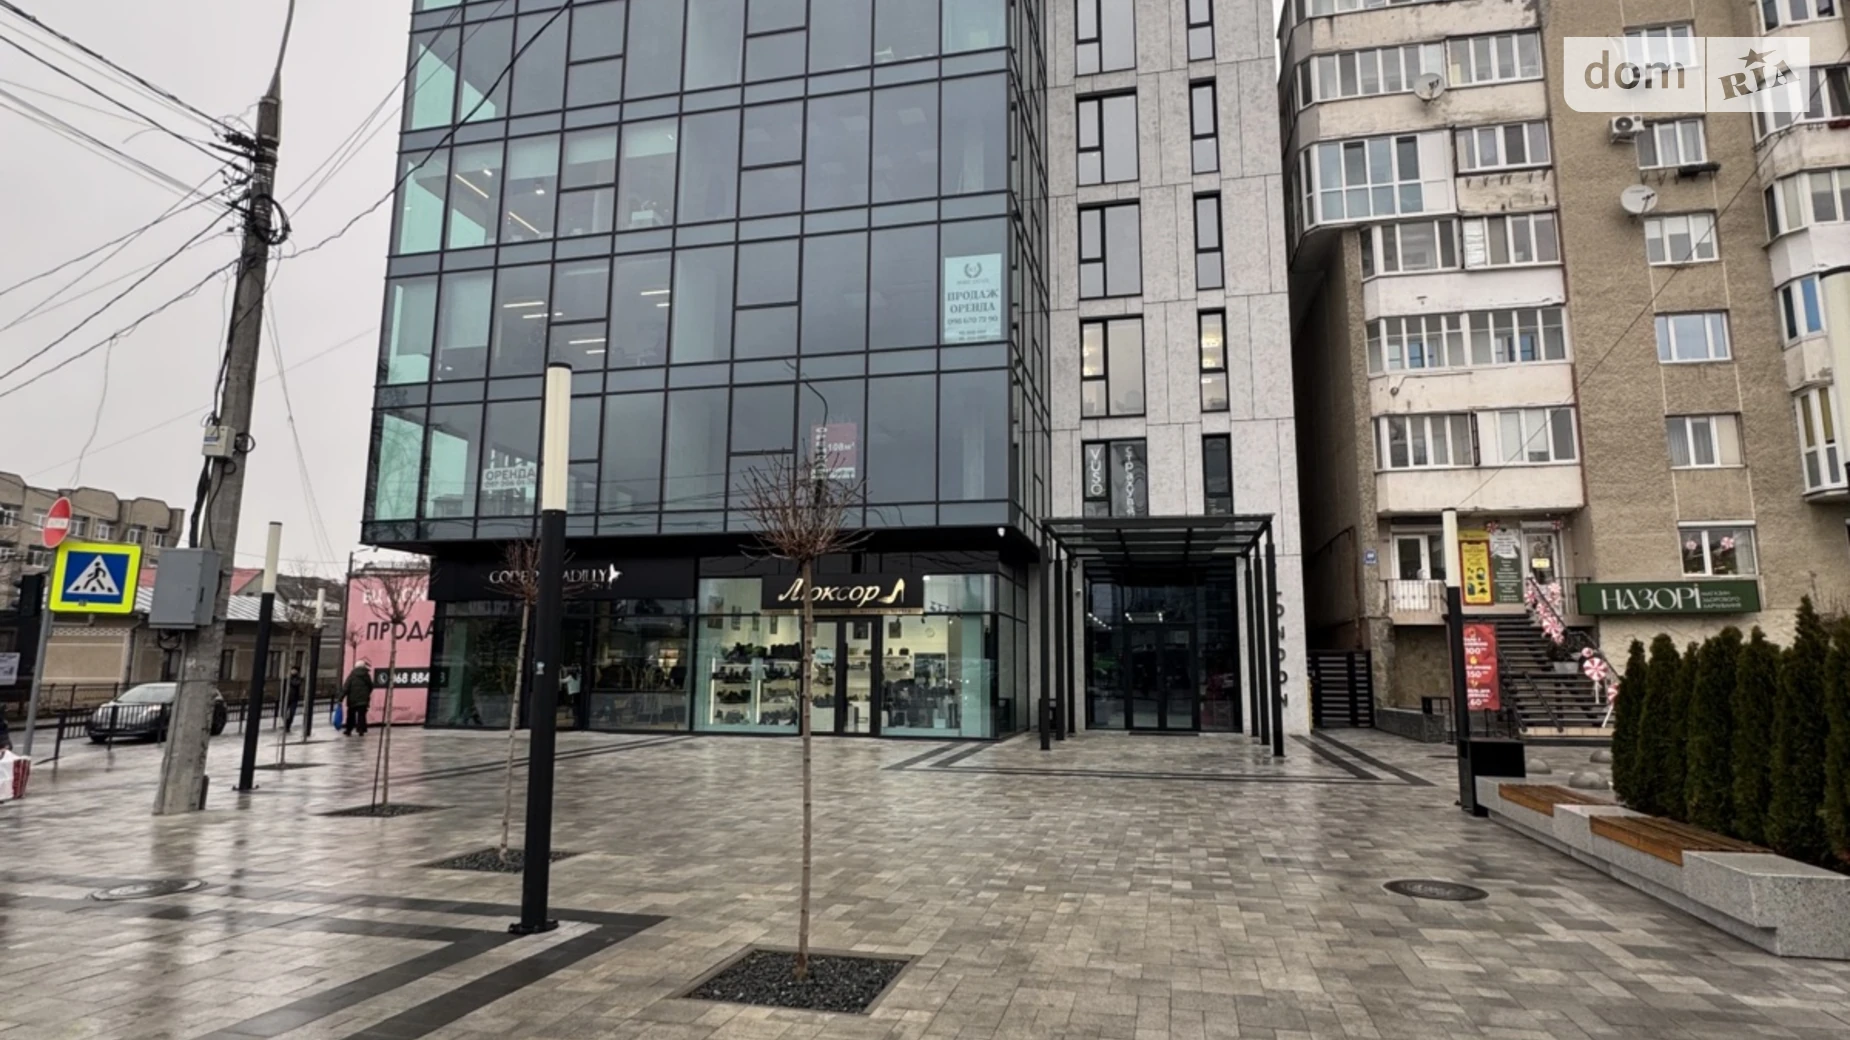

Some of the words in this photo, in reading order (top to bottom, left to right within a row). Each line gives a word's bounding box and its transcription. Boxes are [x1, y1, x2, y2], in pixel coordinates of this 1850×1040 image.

[947, 289, 999, 301] ПРОДАЖ
[949, 302, 996, 313] ОРЕНДА
[485, 468, 536, 481] ОРЕНДА
[1091, 449, 1103, 495] VUSO
[1601, 583, 1701, 610] НАЗОРІ
